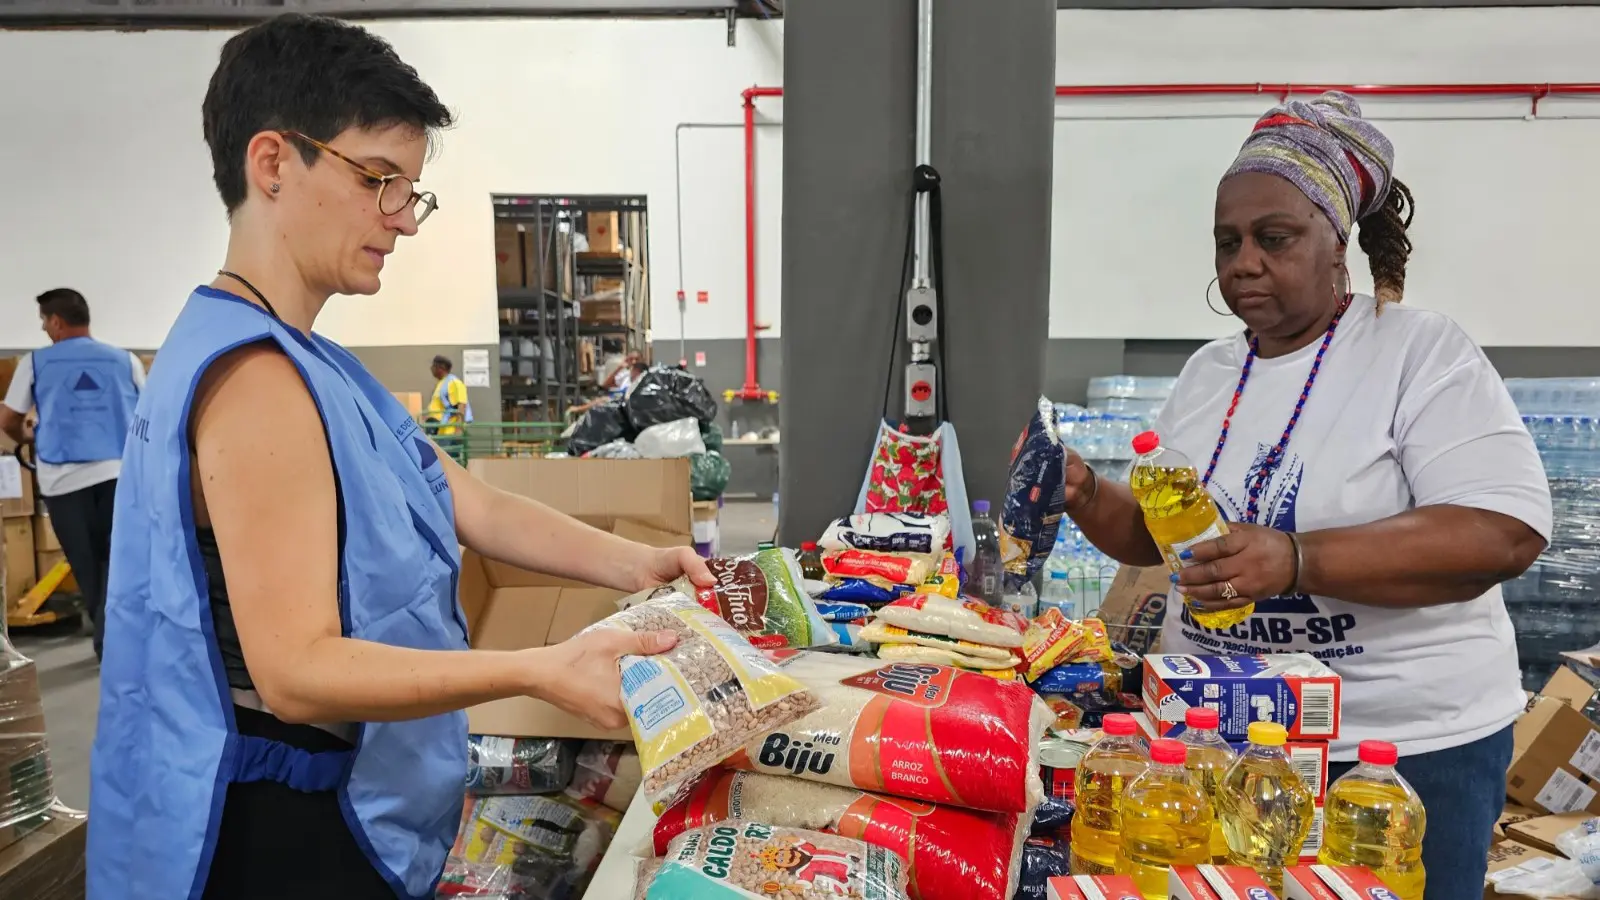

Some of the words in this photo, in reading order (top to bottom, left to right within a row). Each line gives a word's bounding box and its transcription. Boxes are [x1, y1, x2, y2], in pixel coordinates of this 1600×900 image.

[130, 414, 149, 443] IVIL
[1181, 603, 1356, 645] INCAB-SP
[1222, 641, 1272, 656] Nacional
[1296, 644, 1364, 660] adição
[878, 663, 941, 695] Biju
[924, 683, 940, 699] Meu
[813, 733, 841, 746] Meu
[759, 732, 834, 775] Biju
[892, 760, 923, 771] ARROZ
[891, 772, 928, 784] BRANCO
[702, 827, 739, 879] CALDO
